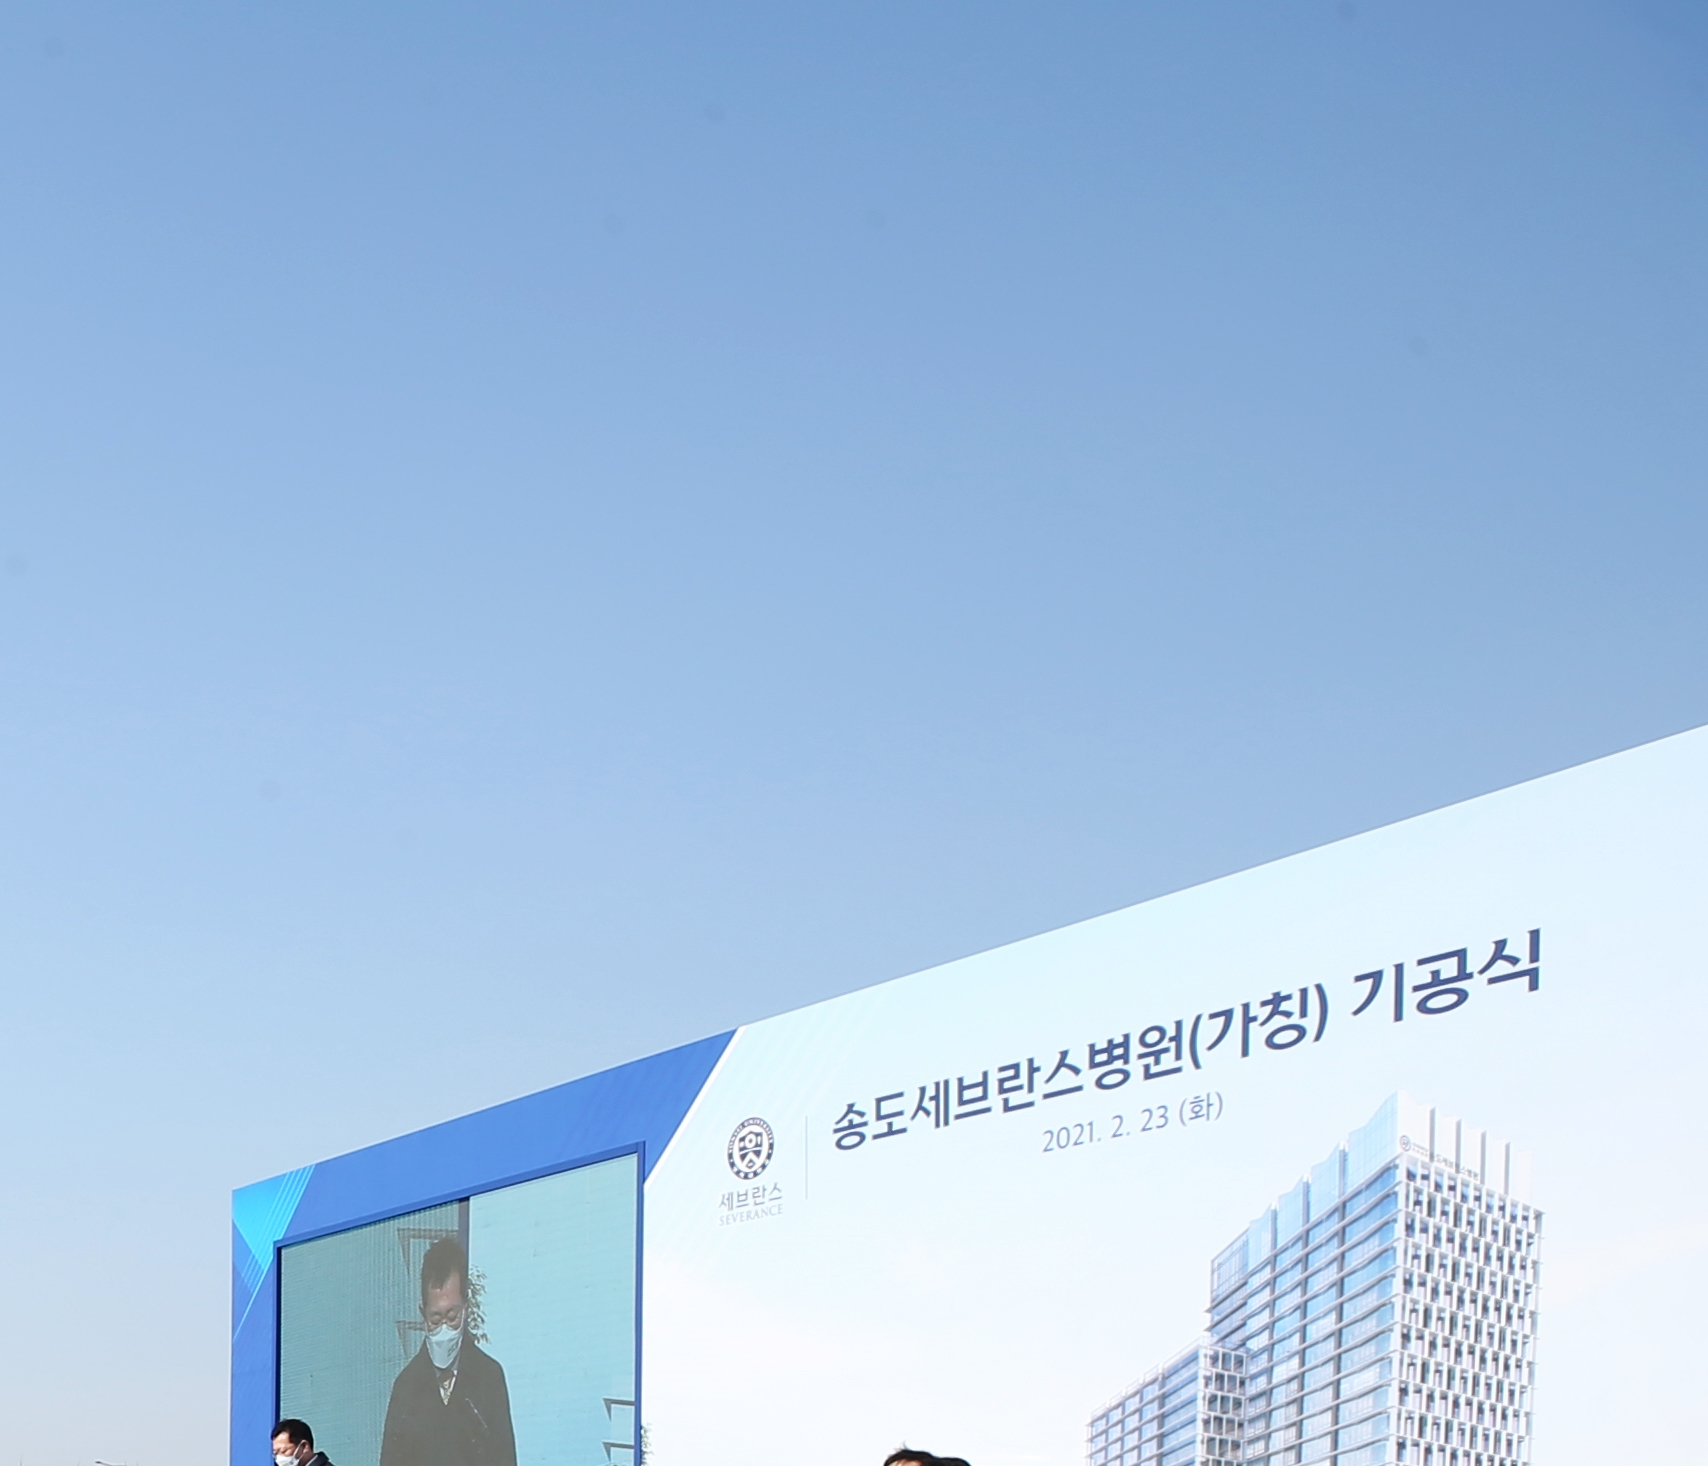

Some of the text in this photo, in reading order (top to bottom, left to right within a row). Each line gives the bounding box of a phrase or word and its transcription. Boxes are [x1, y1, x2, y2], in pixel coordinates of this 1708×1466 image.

[832, 983, 1329, 1151] 송도세브란스병원(가칭)
[1351, 928, 1543, 1022] 기공식
[1042, 1091, 1224, 1153] 2021. 2. 23 (화)
[718, 1182, 783, 1211] 세브란스
[719, 1203, 783, 1226] SEVERANCE
